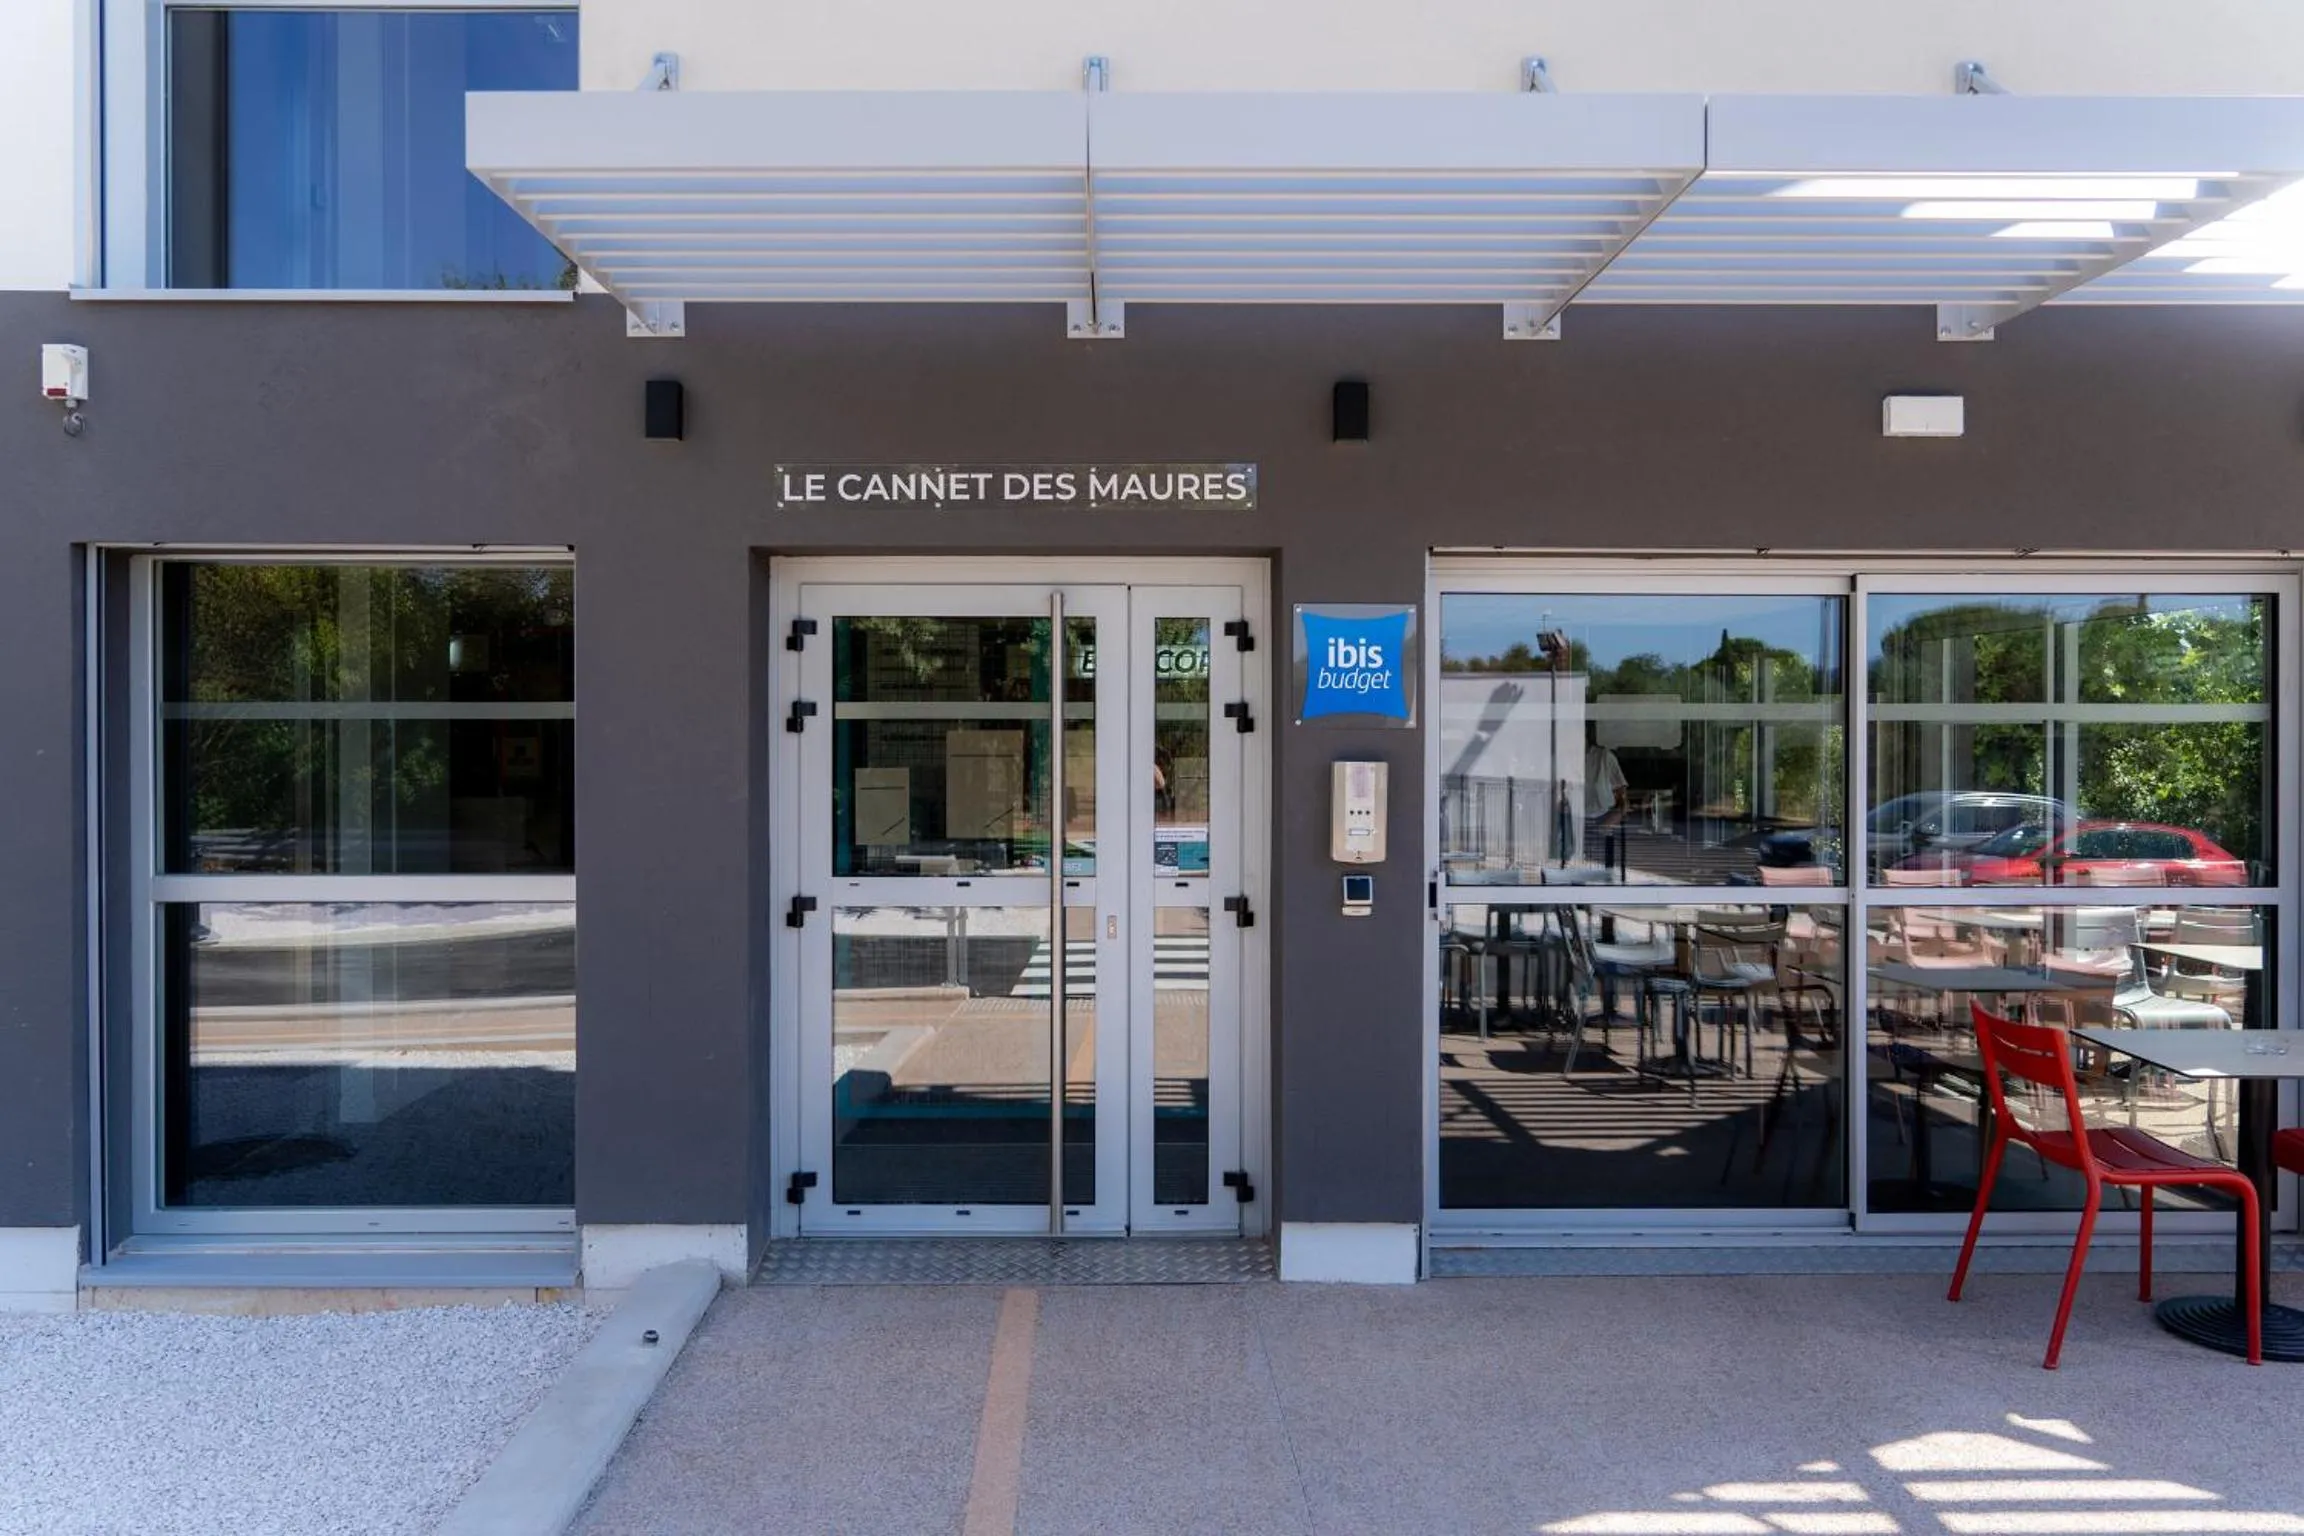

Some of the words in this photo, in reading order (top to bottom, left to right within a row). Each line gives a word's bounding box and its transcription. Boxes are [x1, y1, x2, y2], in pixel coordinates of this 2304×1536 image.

[784, 473, 825, 501] LE
[838, 472, 992, 502] CANNET
[1004, 473, 1076, 502] DES
[1092, 473, 1246, 502] MAURES
[1328, 637, 1383, 668] ibis
[1318, 668, 1392, 694] budget
